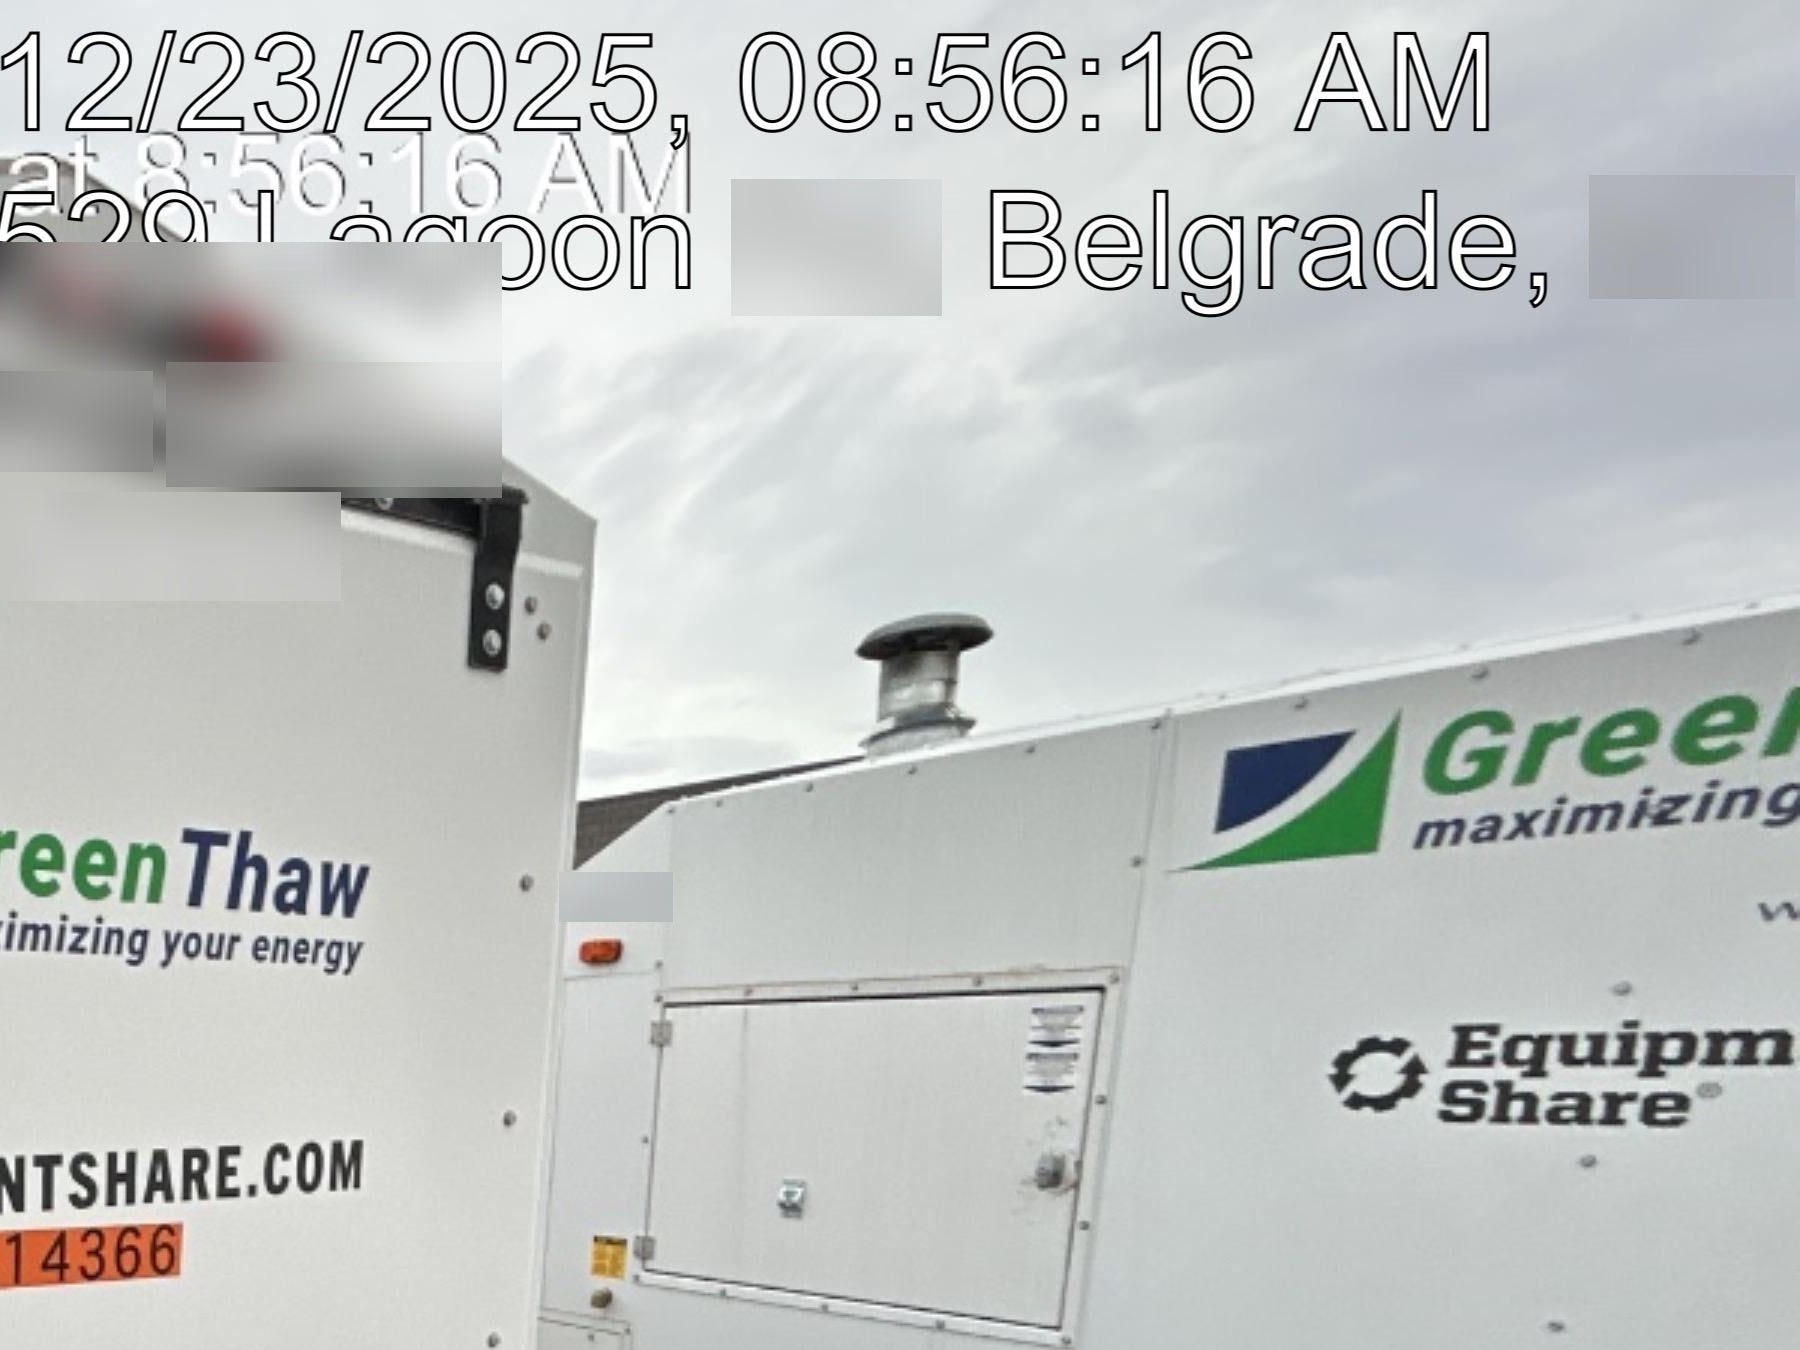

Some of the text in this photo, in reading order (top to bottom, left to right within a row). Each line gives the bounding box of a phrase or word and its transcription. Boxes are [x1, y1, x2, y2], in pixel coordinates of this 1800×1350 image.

[1411, 779, 1800, 851] maximizing
[160, 929, 242, 969] your
[251, 933, 364, 975] energy
[1446, 1019, 1795, 1078] Equipm
